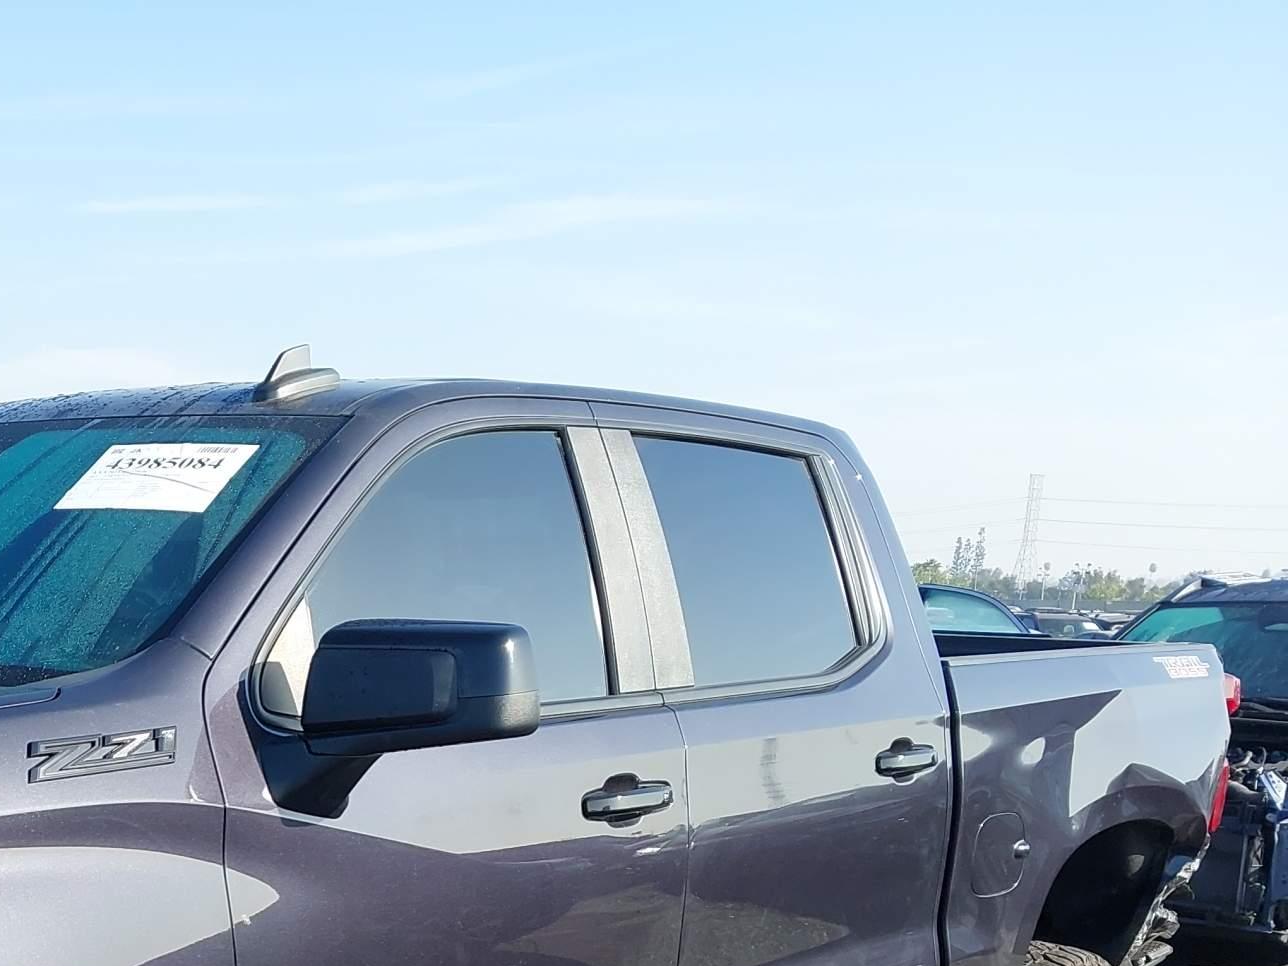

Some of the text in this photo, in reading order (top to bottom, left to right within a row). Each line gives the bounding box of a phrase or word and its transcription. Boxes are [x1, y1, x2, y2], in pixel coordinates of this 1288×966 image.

[105, 457, 225, 469] 43985084
[1152, 655, 1210, 668] TRAIL
[1168, 667, 1209, 679] BOSS
[26, 726, 176, 784] Z71
